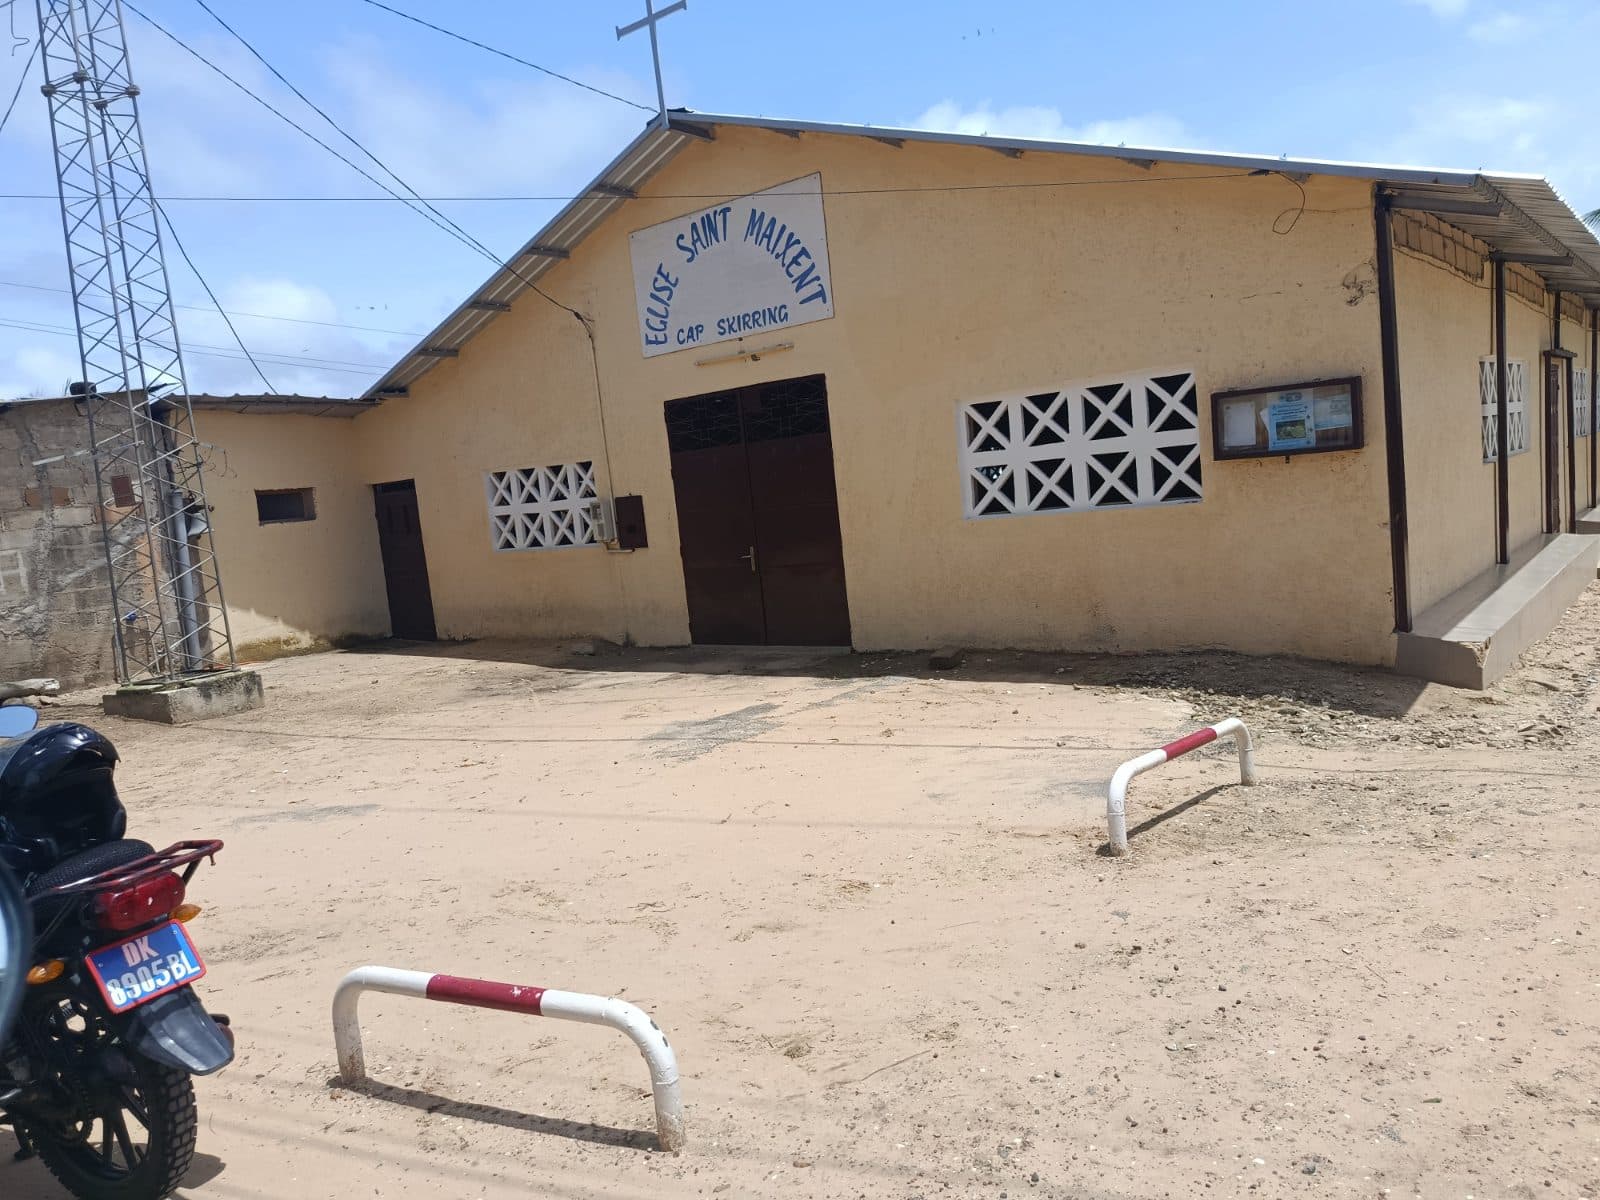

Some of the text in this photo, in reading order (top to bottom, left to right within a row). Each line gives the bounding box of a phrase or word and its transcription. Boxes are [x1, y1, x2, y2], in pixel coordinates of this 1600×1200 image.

[645, 207, 826, 345] EGLISE SAINT MAIXENT
[677, 304, 788, 344] CAP SKIRRING
[121, 935, 159, 967] DK
